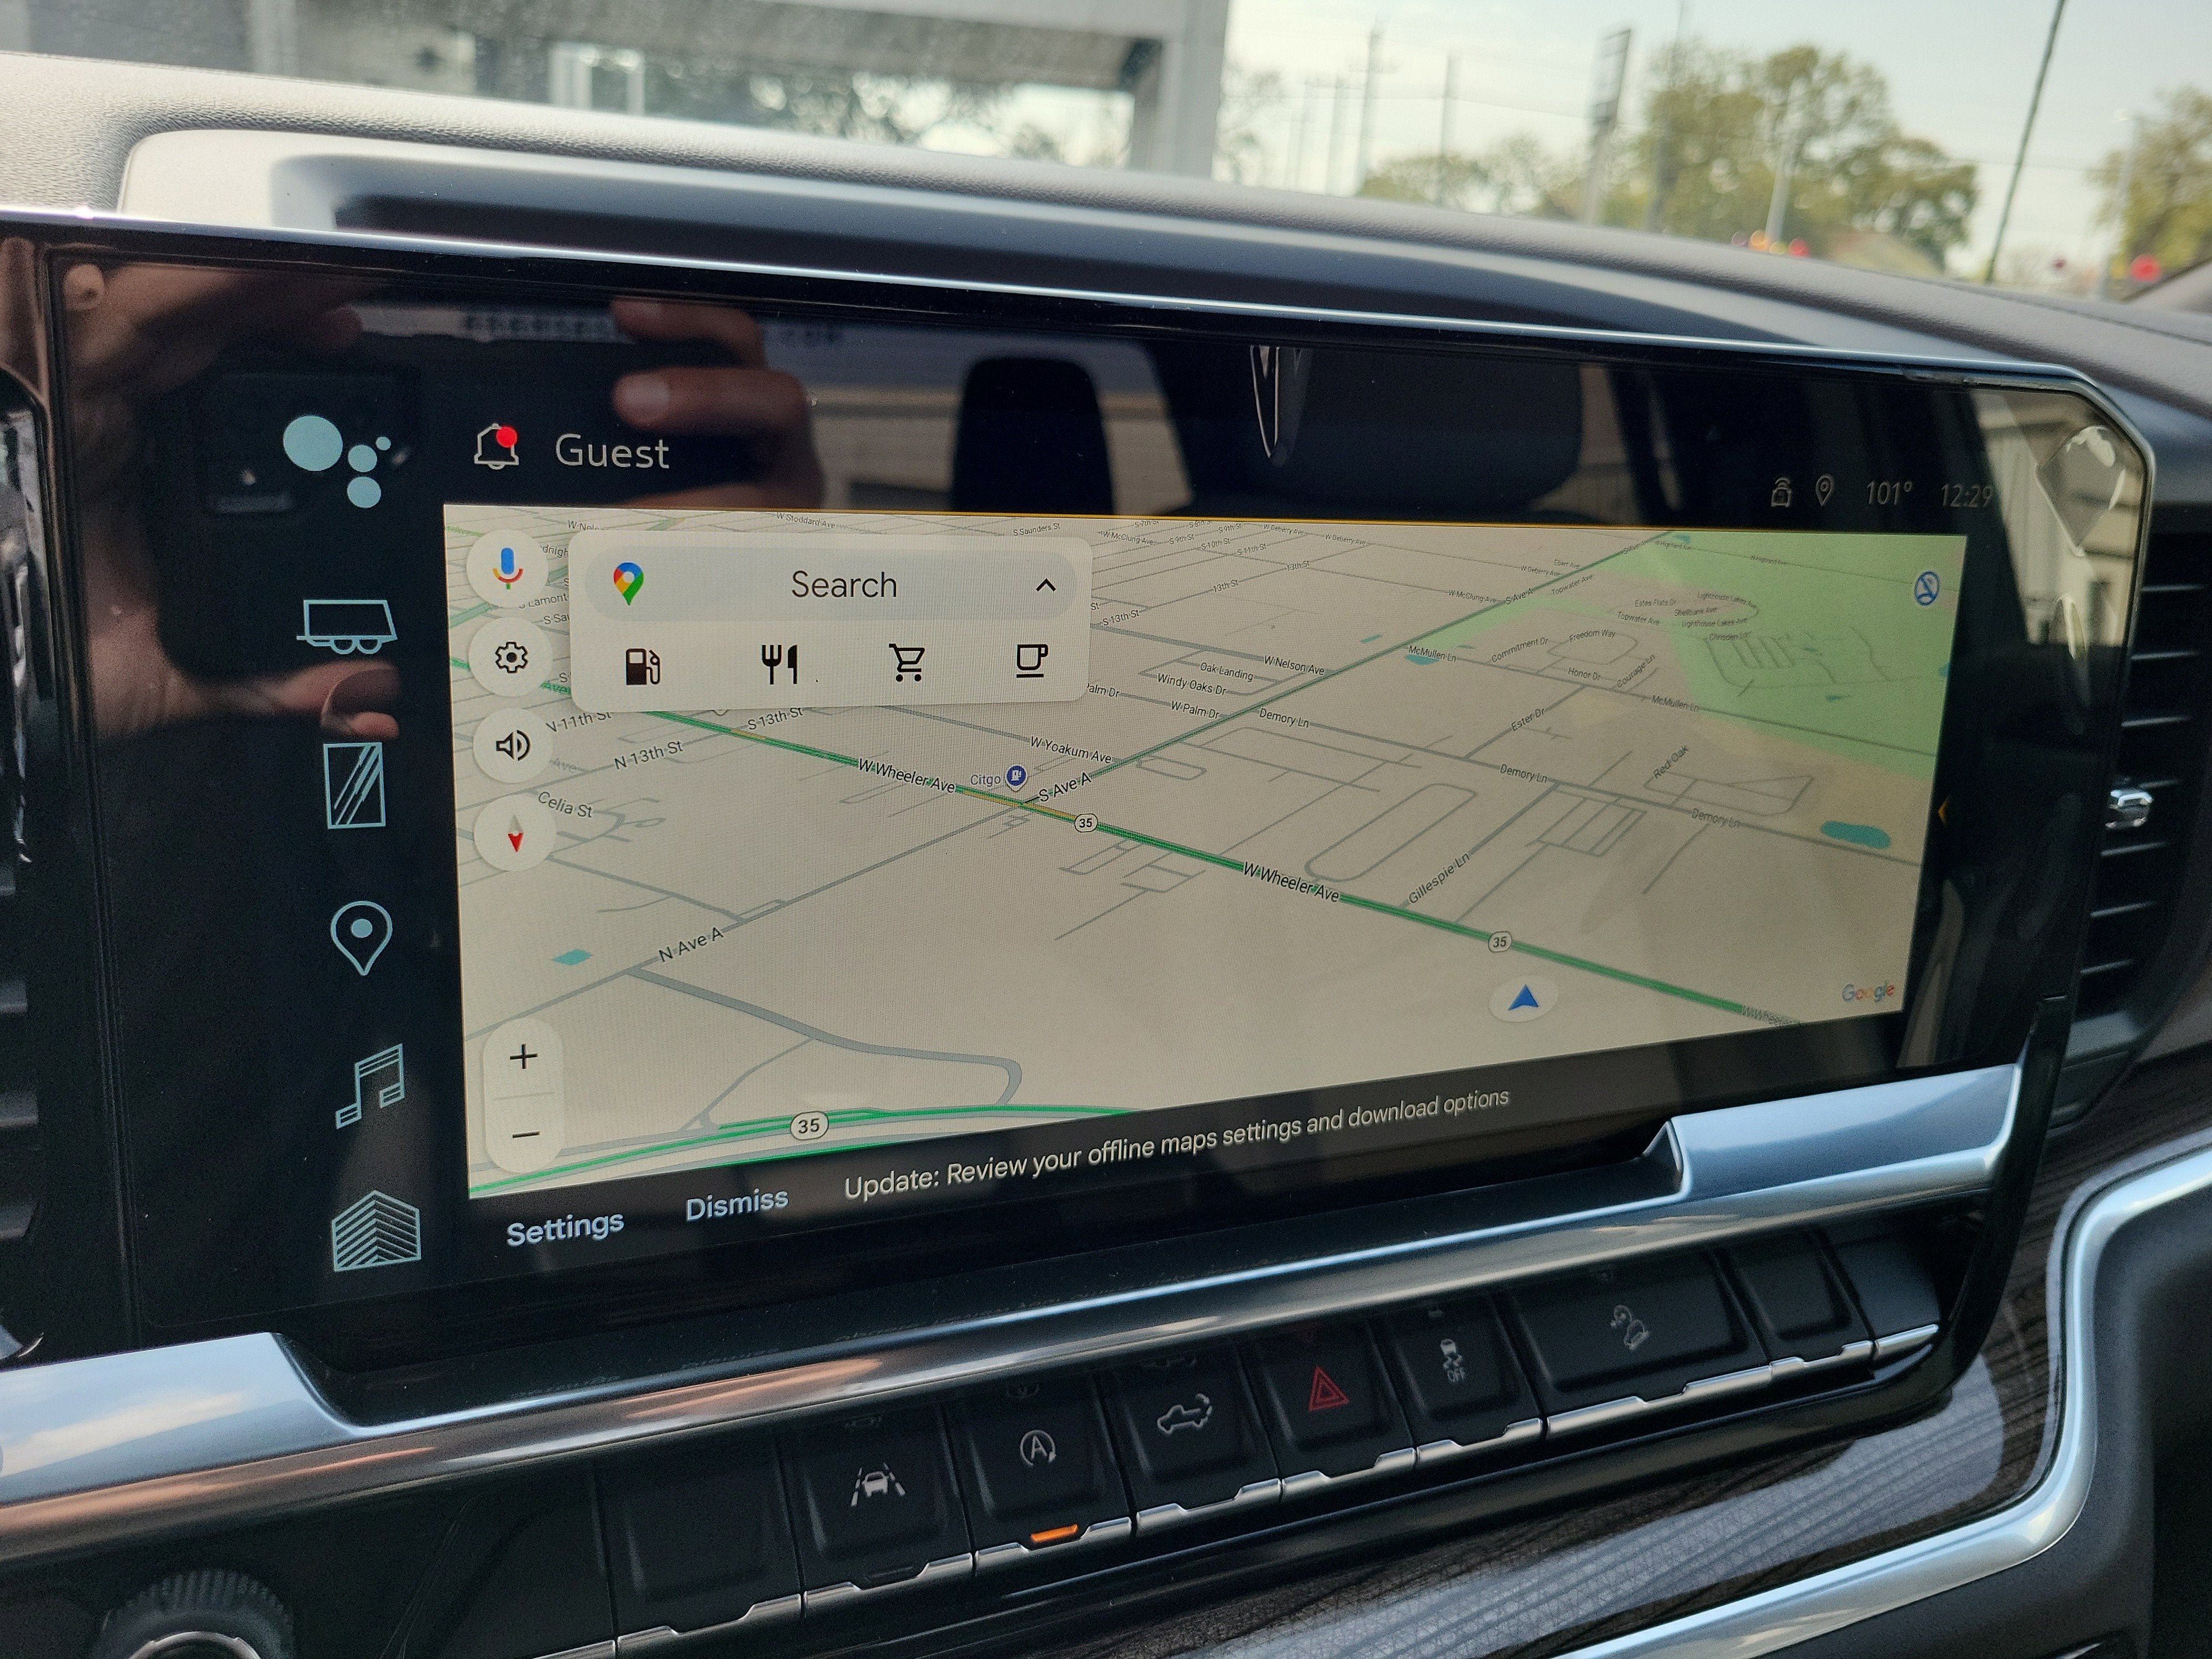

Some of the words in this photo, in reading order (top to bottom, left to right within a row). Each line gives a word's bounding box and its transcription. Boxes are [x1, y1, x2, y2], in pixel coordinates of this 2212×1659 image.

[556, 433, 670, 469] Guest
[1941, 483, 1992, 507] 12:29
[568, 520, 577, 529] W
[1020, 525, 1052, 535] Saunders
[1111, 532, 1140, 544] McClung
[1207, 541, 1222, 549] 10th
[791, 570, 898, 598] Search
[1213, 582, 1229, 593] 13th
[1551, 578, 1580, 595] Topwater
[1581, 573, 1593, 584] Ave
[1456, 591, 1484, 603] McClung
[1484, 596, 1497, 604] Ave
[1505, 596, 1511, 605] S
[1512, 591, 1526, 602] Ave
[1526, 587, 1533, 596] A
[1091, 602, 1099, 611] St
[544, 615, 551, 625] S
[1103, 618, 1109, 626] S
[1110, 613, 1129, 624] 13th
[1131, 609, 1139, 618] St
[1617, 611, 1647, 624] Topwater
[1647, 617, 1660, 626] Ave
[1568, 629, 1599, 643] Freedom
[1601, 629, 1616, 639] Way
[1407, 645, 1446, 661] McMullen
[1448, 653, 1457, 662] Ln
[1491, 639, 1538, 663] Commitment
[1540, 637, 1548, 646] Dr
[1200, 662, 1217, 674] Oak
[1219, 666, 1254, 682] Landing
[1264, 655, 1274, 665] W
[1275, 657, 1306, 672] Nelson
[1307, 664, 1324, 676] Ave
[1568, 667, 1590, 680] Honor
[1592, 671, 1601, 681] Dr
[1616, 662, 1646, 688] Courage
[1645, 653, 1656, 666] Ln
[1087, 682, 1107, 696] alm
[1108, 687, 1120, 698] Dr
[1157, 673, 1188, 690] Windy
[1189, 680, 1213, 693] Oaks
[1215, 685, 1227, 696] Dr
[1171, 700, 1181, 711] W
[1182, 703, 1207, 717] Palm
[1208, 708, 1219, 719] Dr
[1651, 695, 1688, 711] McMullen
[1689, 703, 1699, 712] Ln
[561, 712, 593, 730] 11th
[748, 719, 757, 730] S
[759, 711, 788, 728] 13th
[790, 707, 804, 719] St
[1259, 708, 1296, 727] Demory
[1297, 718, 1310, 728] Ln
[1510, 713, 1533, 732] Ester
[1534, 707, 1546, 719] Dr
[614, 758, 628, 770] N
[632, 745, 664, 762] 13th
[667, 740, 684, 754] St
[1030, 736, 1043, 748] W
[1044, 740, 1089, 759] Yoakum
[1091, 750, 1112, 764] Ave
[1652, 760, 1672, 779] Red
[1671, 745, 1689, 763] Oak
[858, 758, 873, 773] W
[875, 762, 928, 787] Wheeler
[930, 778, 956, 794] Ave
[970, 774, 1001, 787] Citgo
[1500, 764, 1535, 782] Demory
[1536, 774, 1547, 784] Ln
[1039, 789, 1049, 802] S
[1052, 779, 1078, 797] Ave
[1080, 772, 1092, 786] A
[538, 791, 573, 815] Celia
[577, 804, 593, 818] St
[1079, 818, 1093, 829] 35
[1691, 807, 1726, 827] Demory
[1728, 818, 1740, 829] Ln
[1243, 861, 1260, 878] W
[1260, 866, 1314, 895] Wheeler
[1314, 885, 1339, 903] Ave
[1408, 864, 1455, 905] Gillespie
[1454, 852, 1470, 869] Ln
[659, 946, 674, 962] N
[679, 935, 708, 956] Ave
[712, 927, 724, 941] A
[1493, 936, 1507, 948] 35
[1841, 980, 1895, 1003] Google
[797, 1117, 820, 1135] 35
[844, 1169, 940, 1203] Update:
[946, 1155, 1027, 1185] Review
[1031, 1149, 1082, 1180] your
[1087, 1137, 1155, 1166] offline
[1161, 1130, 1217, 1157] maps
[1222, 1118, 1302, 1146] settings
[1306, 1109, 1343, 1132] and
[1348, 1095, 1438, 1127] download
[1442, 1089, 1510, 1118] options
[686, 1188, 789, 1222] Dismiss
[507, 1213, 624, 1247] Settings
[1447, 1366, 1466, 1383] OFF
